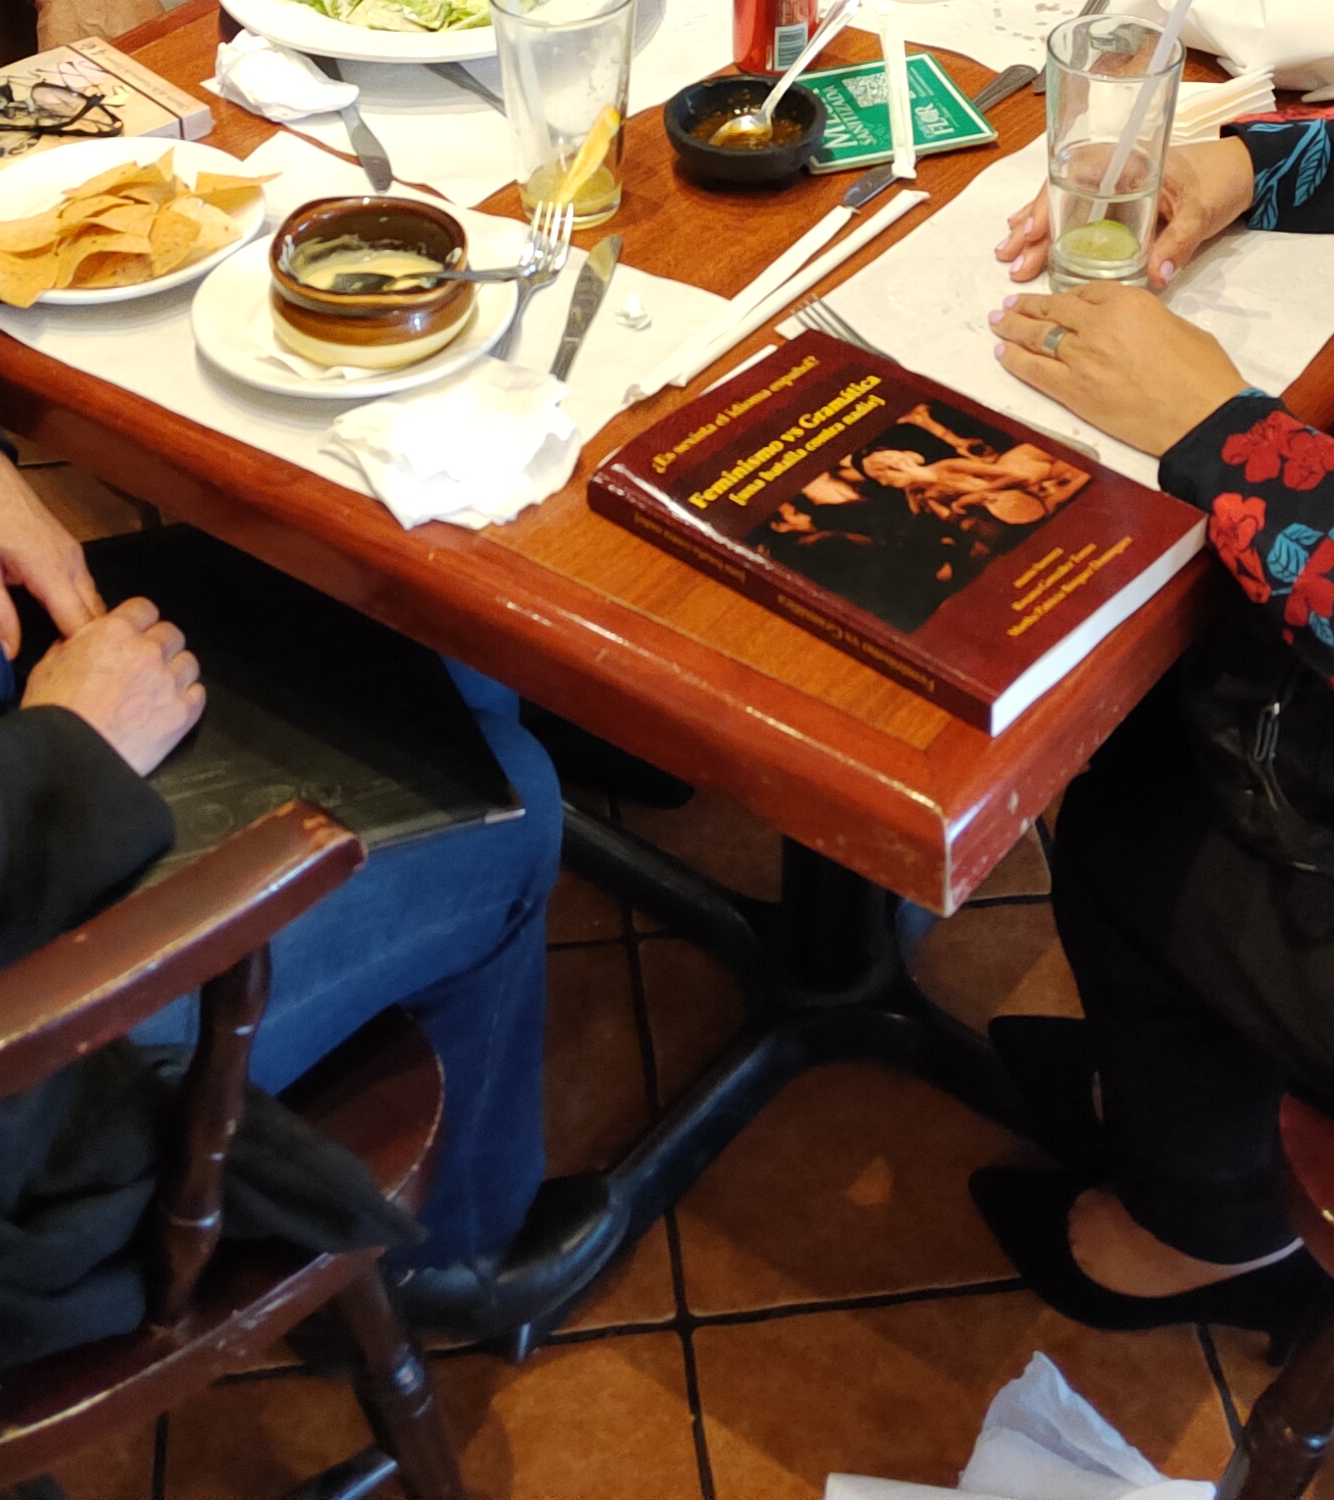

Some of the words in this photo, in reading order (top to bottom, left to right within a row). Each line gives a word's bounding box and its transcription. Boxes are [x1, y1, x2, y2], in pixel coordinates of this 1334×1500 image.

[688, 440, 790, 509] Feminismo
[779, 427, 805, 445] vs
[799, 376, 881, 433] Gramática
